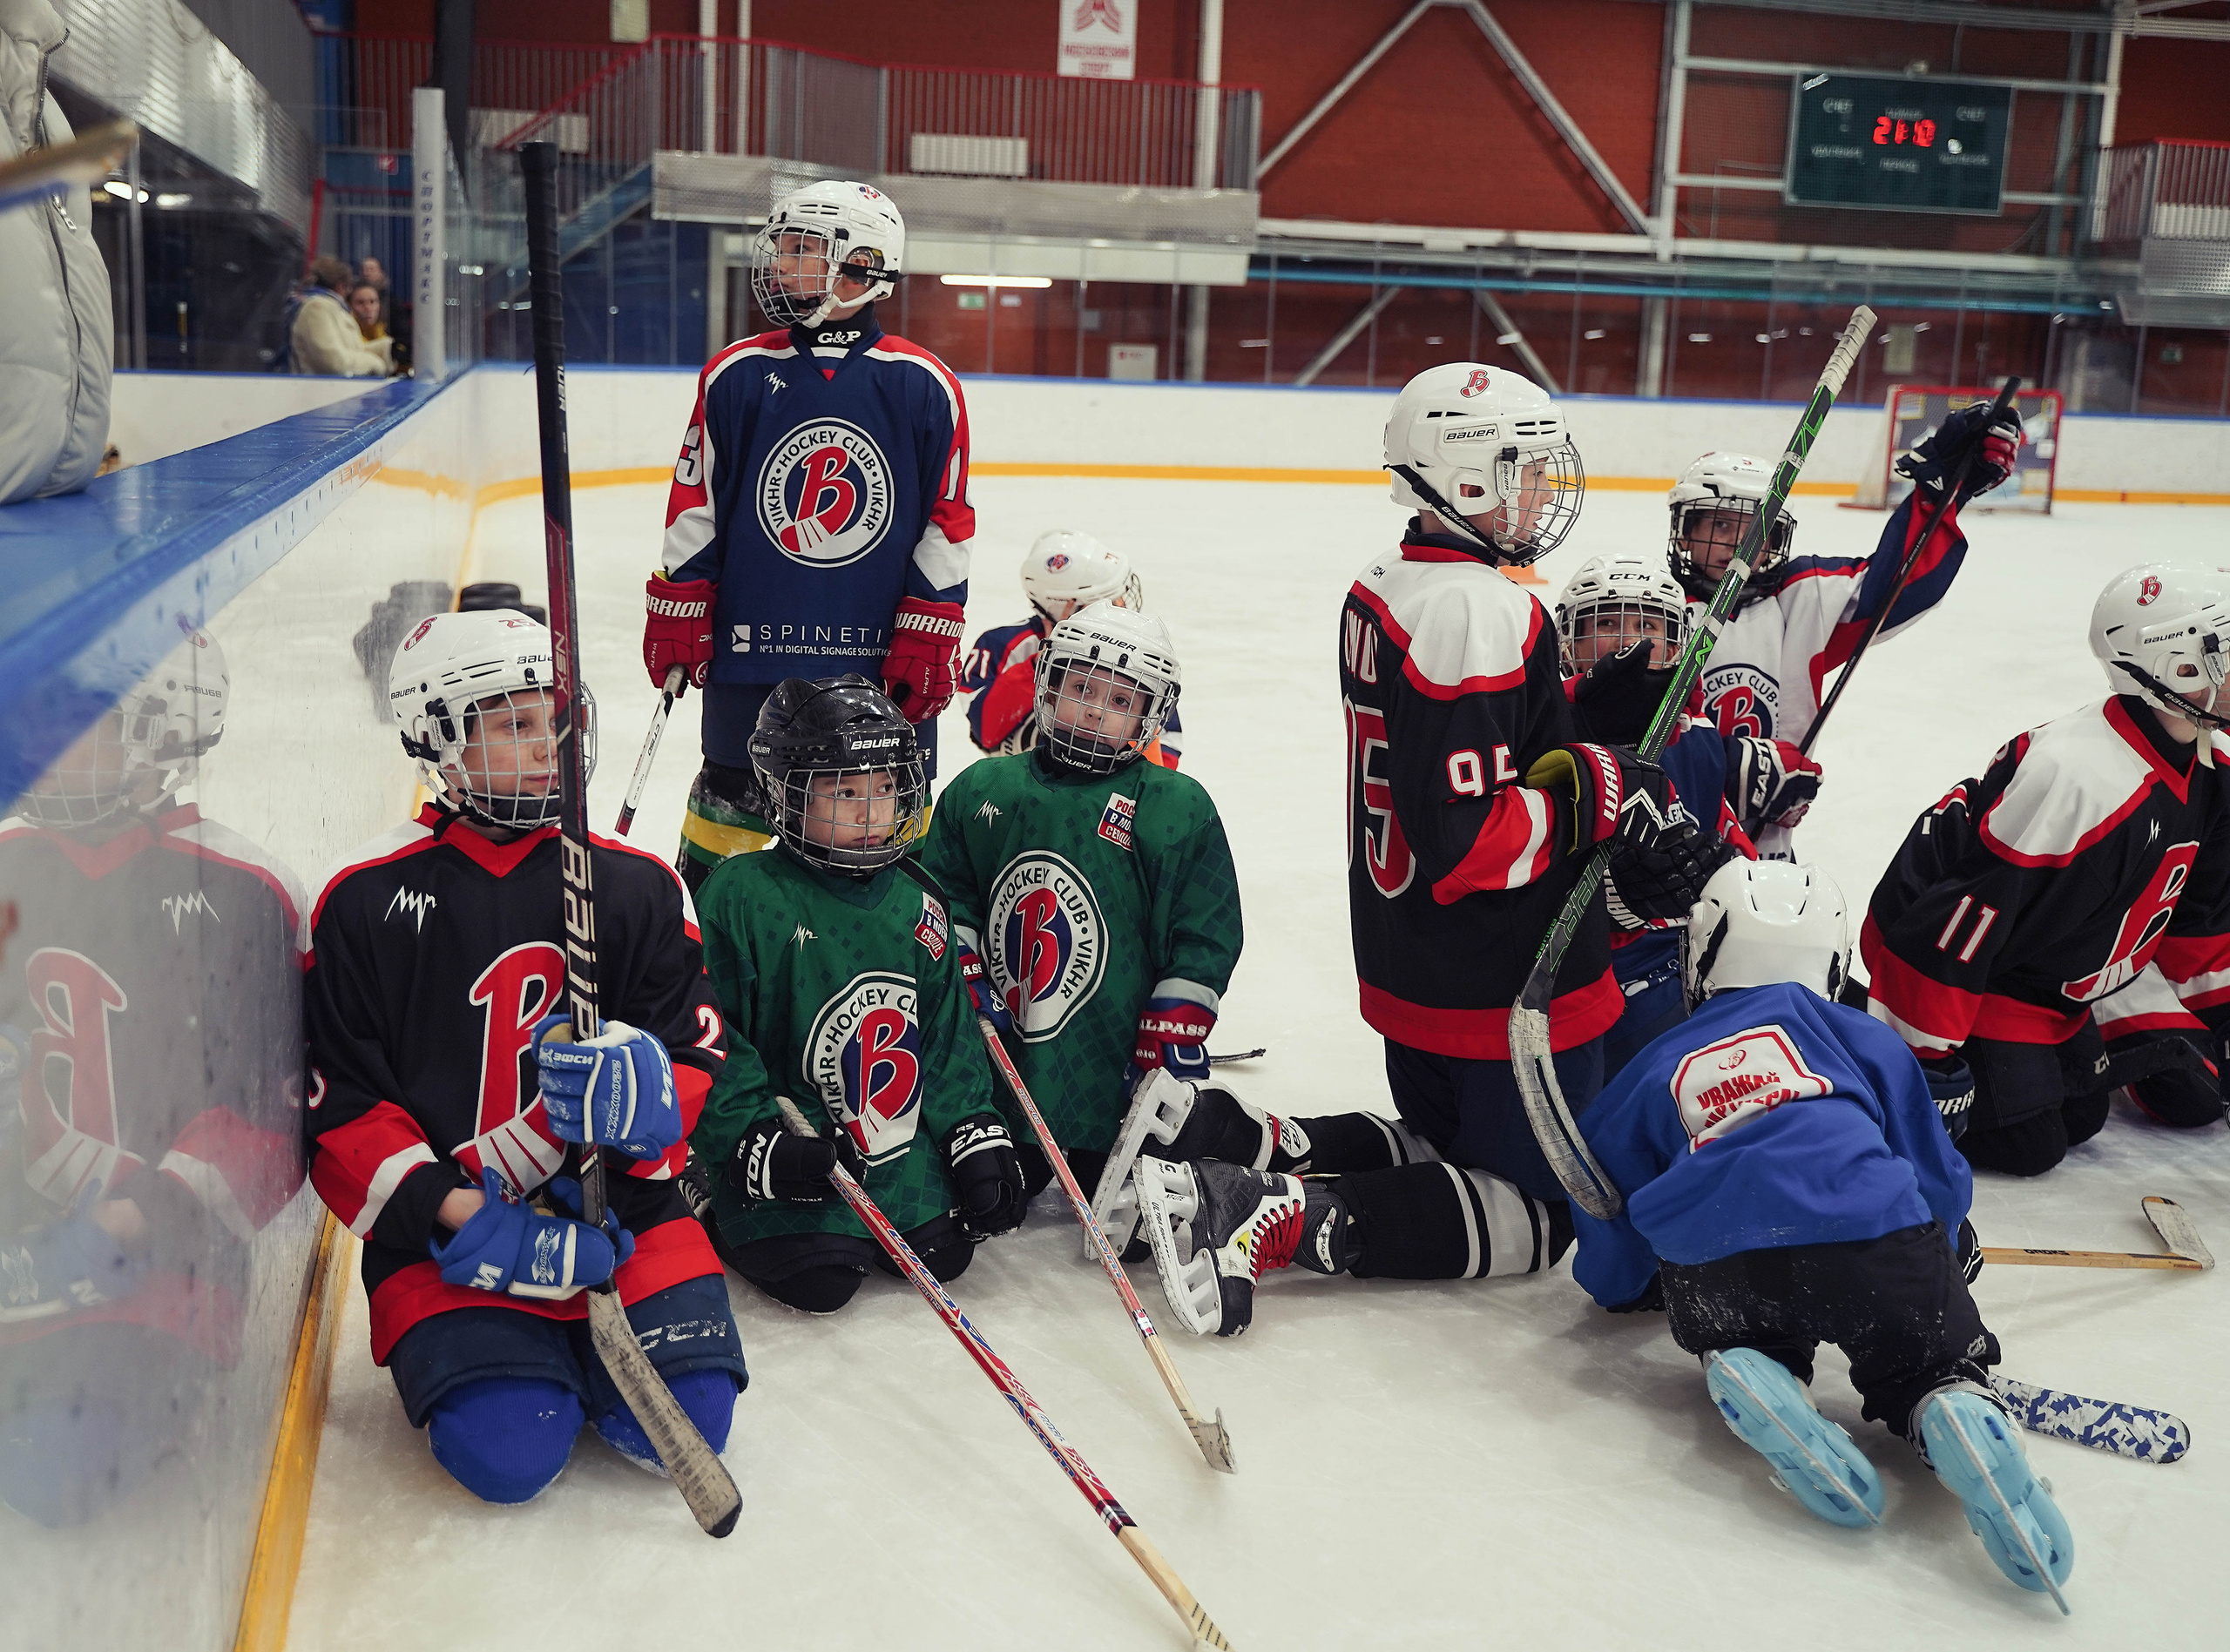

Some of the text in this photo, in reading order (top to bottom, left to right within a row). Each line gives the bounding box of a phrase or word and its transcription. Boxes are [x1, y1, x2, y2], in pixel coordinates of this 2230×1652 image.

[817, 330, 862, 345] G&P
[1446, 428, 1497, 441] BAUER
[779, 430, 876, 469] HOCKEY CLUB
[767, 475, 786, 529] VIKHR
[862, 479, 884, 532] VIKHR
[1441, 505, 1477, 533] BAUER
[1608, 572, 1652, 582] CCM
[497, 618, 537, 629] 25
[760, 624, 883, 644] SPINETI
[1089, 631, 1138, 652] BAUER
[2143, 630, 2184, 644] BAUER
[775, 644, 783, 654] IN
[785, 645, 819, 655] DIGITAL
[821, 646, 856, 656] SIGNAGE
[554, 630, 568, 696] NSX
[391, 686, 416, 700] BAUER
[2164, 692, 2201, 717] BAUER
[752, 744, 771, 755] BAUER
[851, 737, 901, 751] BAUER
[1751, 738, 1776, 809] EAST
[999, 866, 1089, 925] HOCKEY CLUB
[1935, 893, 1999, 964] 11
[1060, 938, 1094, 1001] VIKHR
[828, 988, 916, 1046] HOCKEY CL
[956, 1122, 975, 1134] RS
[737, 1139, 747, 1159] RS
[747, 1132, 771, 1201] TON
[1076, 1200, 1124, 1283] Atom
[1004, 1392, 1078, 1480] Atom
